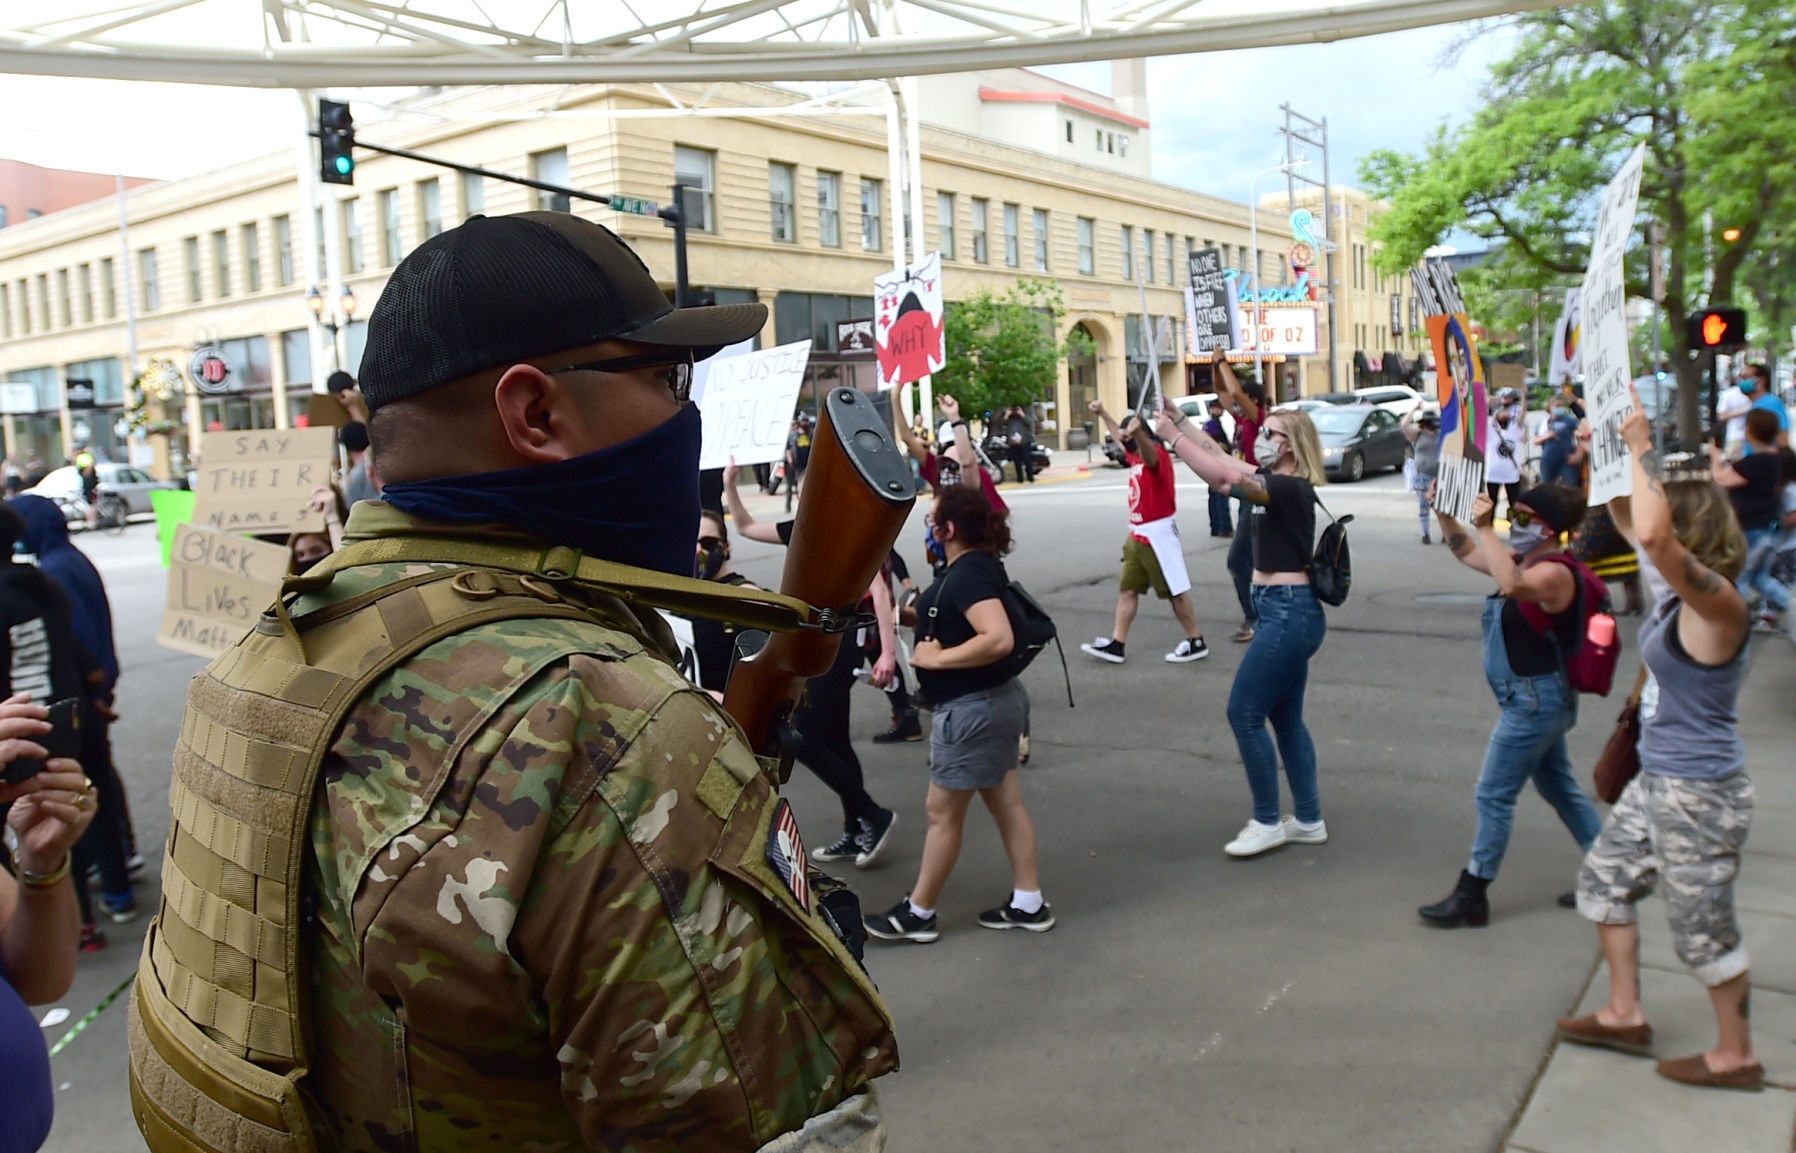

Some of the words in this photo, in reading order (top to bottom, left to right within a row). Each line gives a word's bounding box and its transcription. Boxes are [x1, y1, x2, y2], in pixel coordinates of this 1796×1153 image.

[1191, 257, 1203, 275] NO
[1202, 253, 1218, 272] ONE
[1193, 275, 1207, 293] IS
[1205, 271, 1225, 292] FREE
[1195, 290, 1215, 309] WHEN
[1197, 305, 1228, 325] OTHERS
[891, 321, 928, 356] WHY
[1198, 322, 1214, 336] ARE
[1261, 328, 1277, 343] OF
[235, 436, 290, 455] SAY
[209, 463, 313, 493] THEIR
[208, 508, 308, 525] NAMES
[181, 530, 253, 577] Black
[181, 567, 250, 620] Lives
[171, 617, 236, 650] Matt
